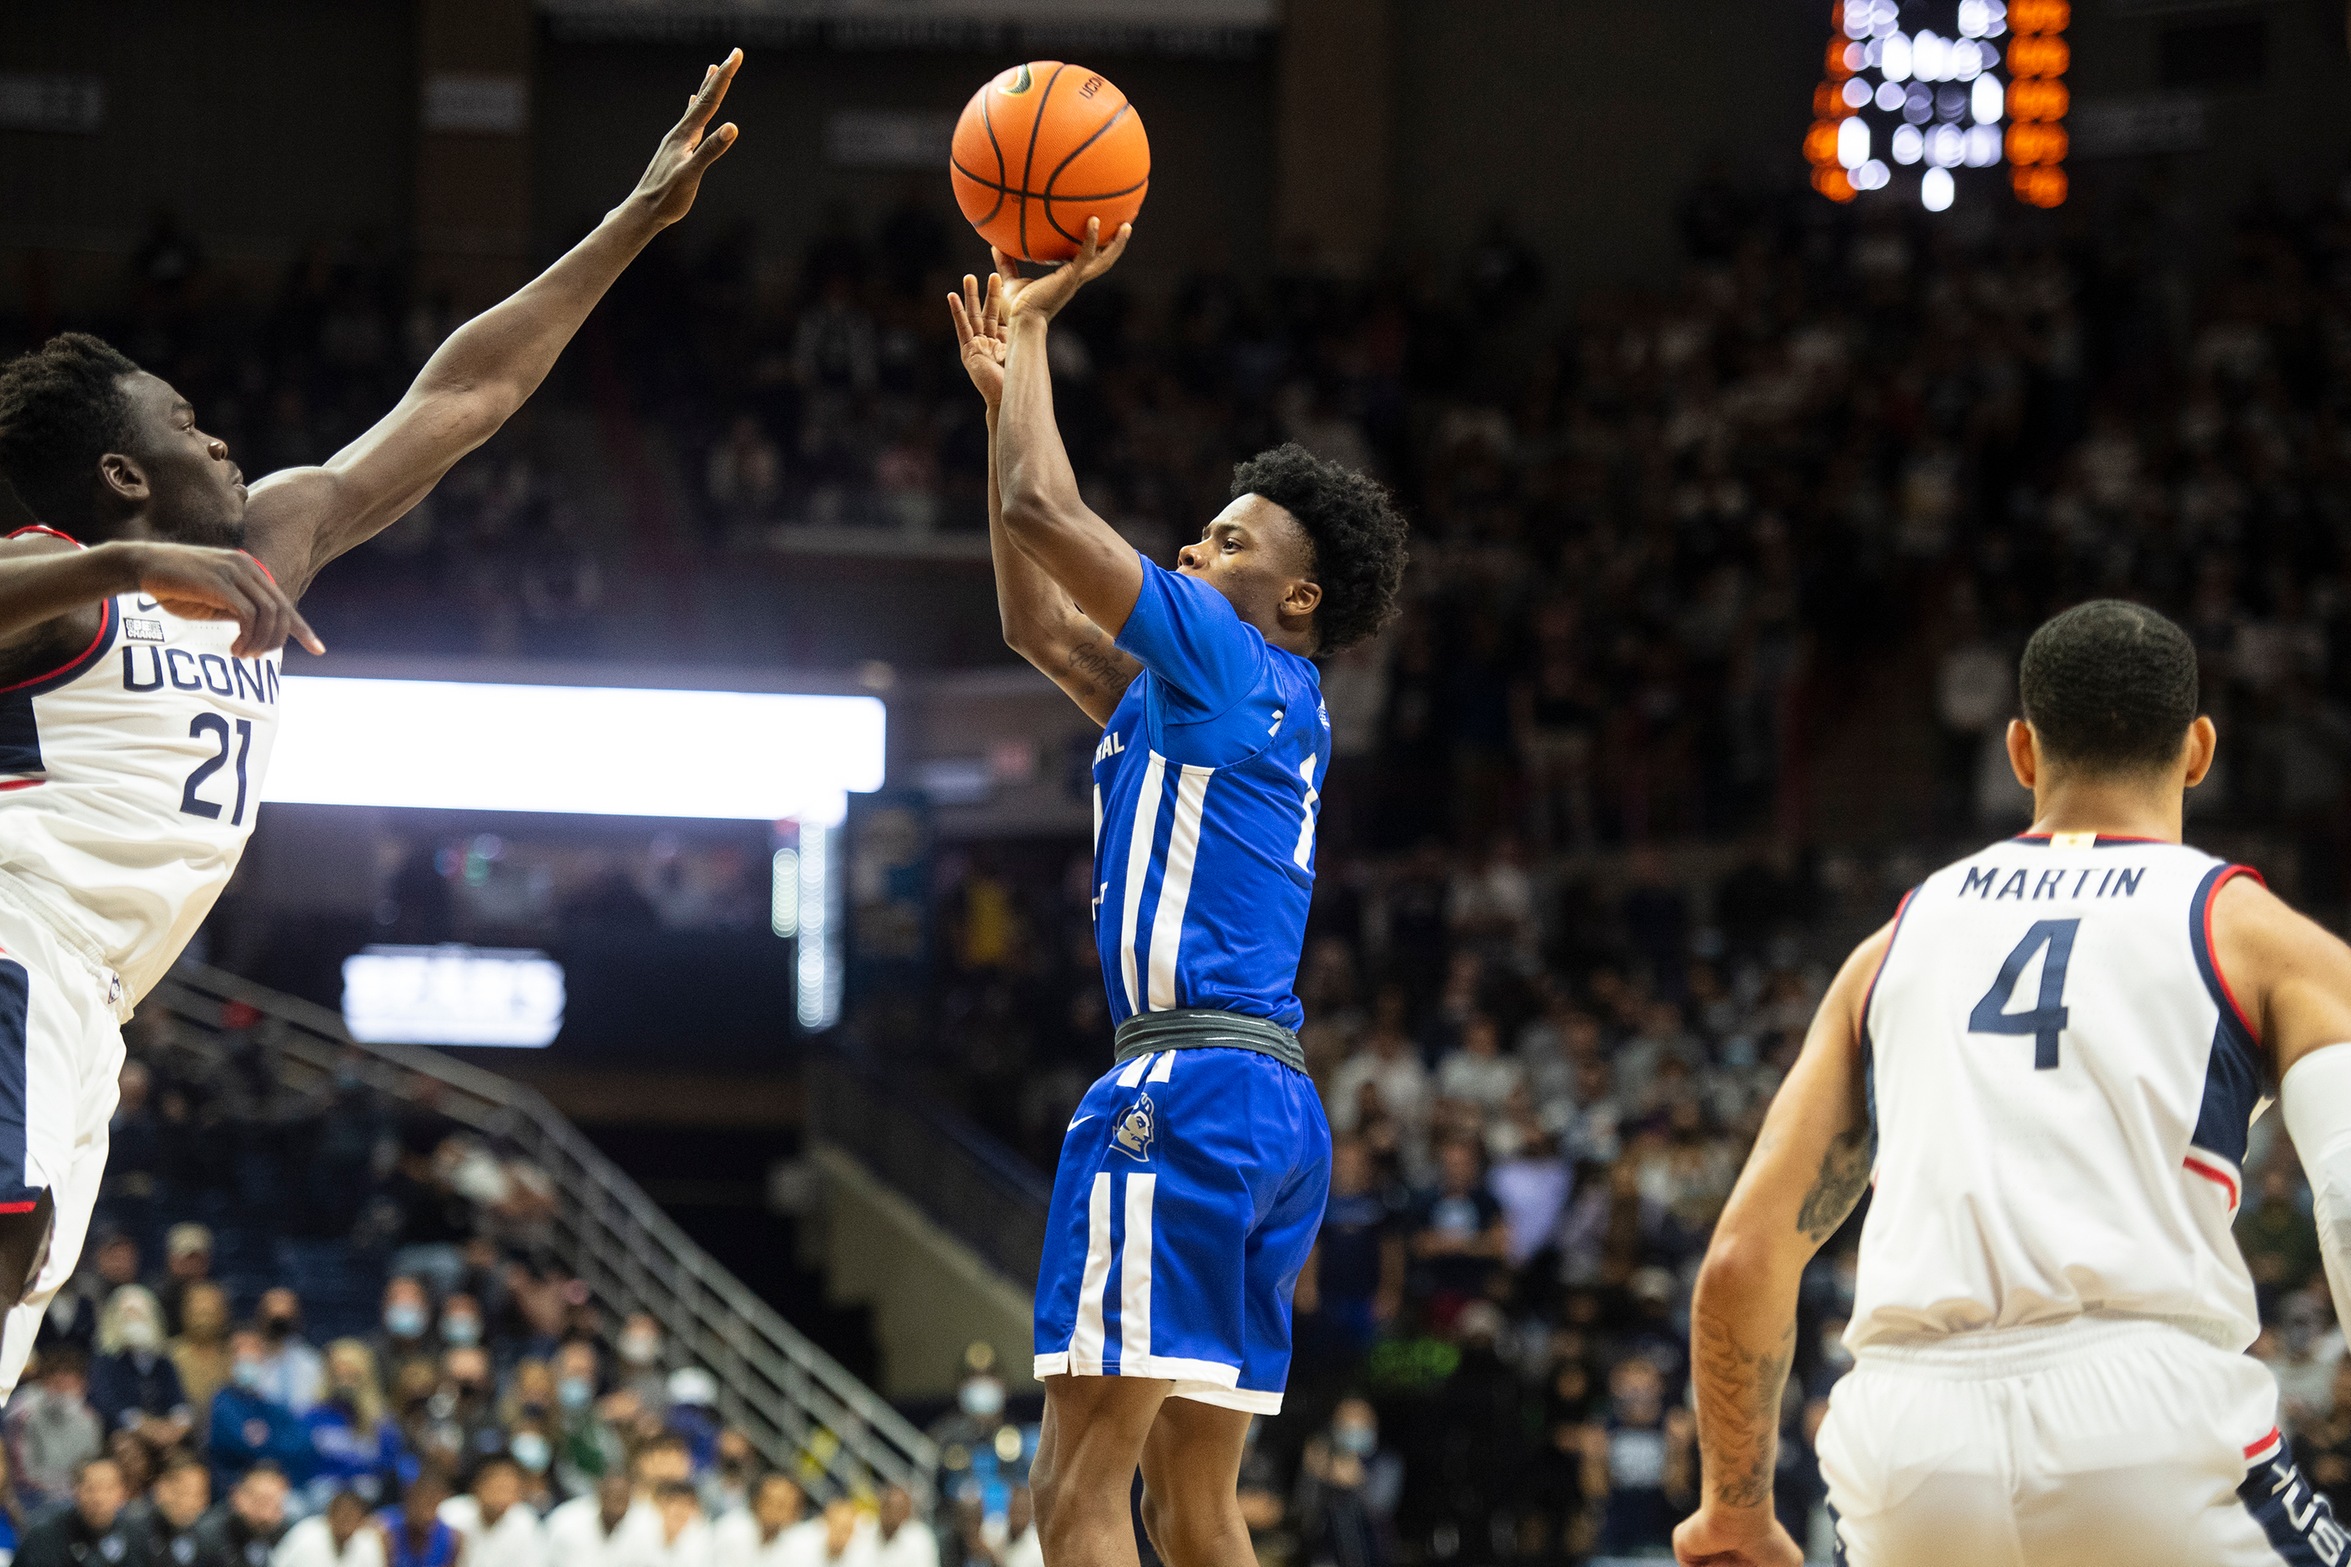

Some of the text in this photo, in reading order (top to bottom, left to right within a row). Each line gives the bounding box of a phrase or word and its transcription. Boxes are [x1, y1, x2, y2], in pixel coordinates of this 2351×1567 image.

[179, 712, 251, 827] 21
[1958, 866, 2148, 901] MARTIN
[1968, 918, 2081, 1071] 4
